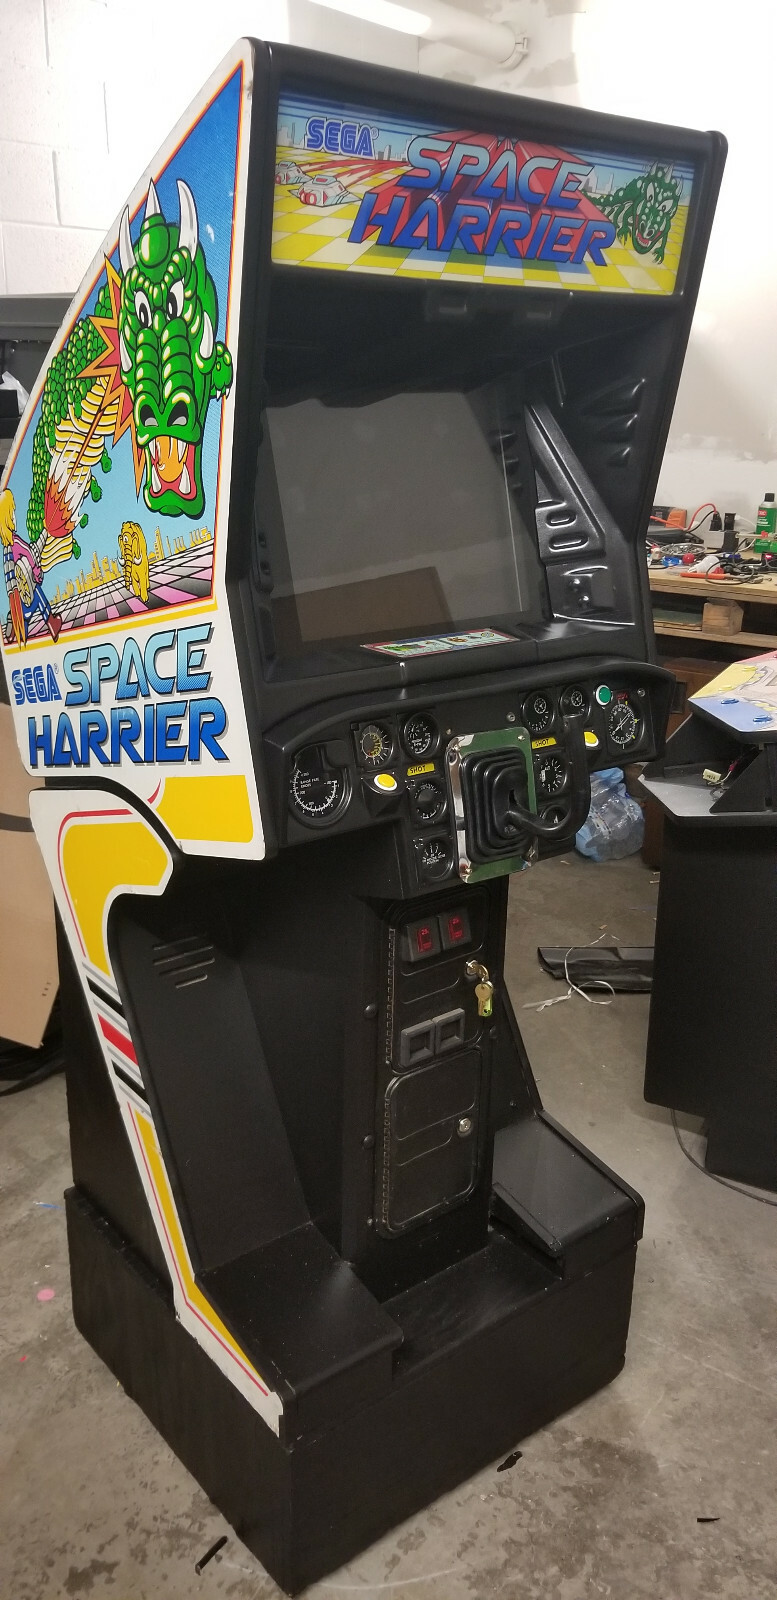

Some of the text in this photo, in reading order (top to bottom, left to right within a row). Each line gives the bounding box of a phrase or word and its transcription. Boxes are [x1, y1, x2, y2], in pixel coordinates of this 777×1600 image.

[304, 116, 375, 160] SEGA
[397, 134, 595, 208] SPACE
[347, 192, 616, 266] HARRIER
[12, 664, 62, 705] SEGA
[63, 622, 213, 706] SPACE
[28, 697, 229, 768] HARRIER
[535, 739, 549, 747] SHOT
[410, 765, 426, 774] SHOT
